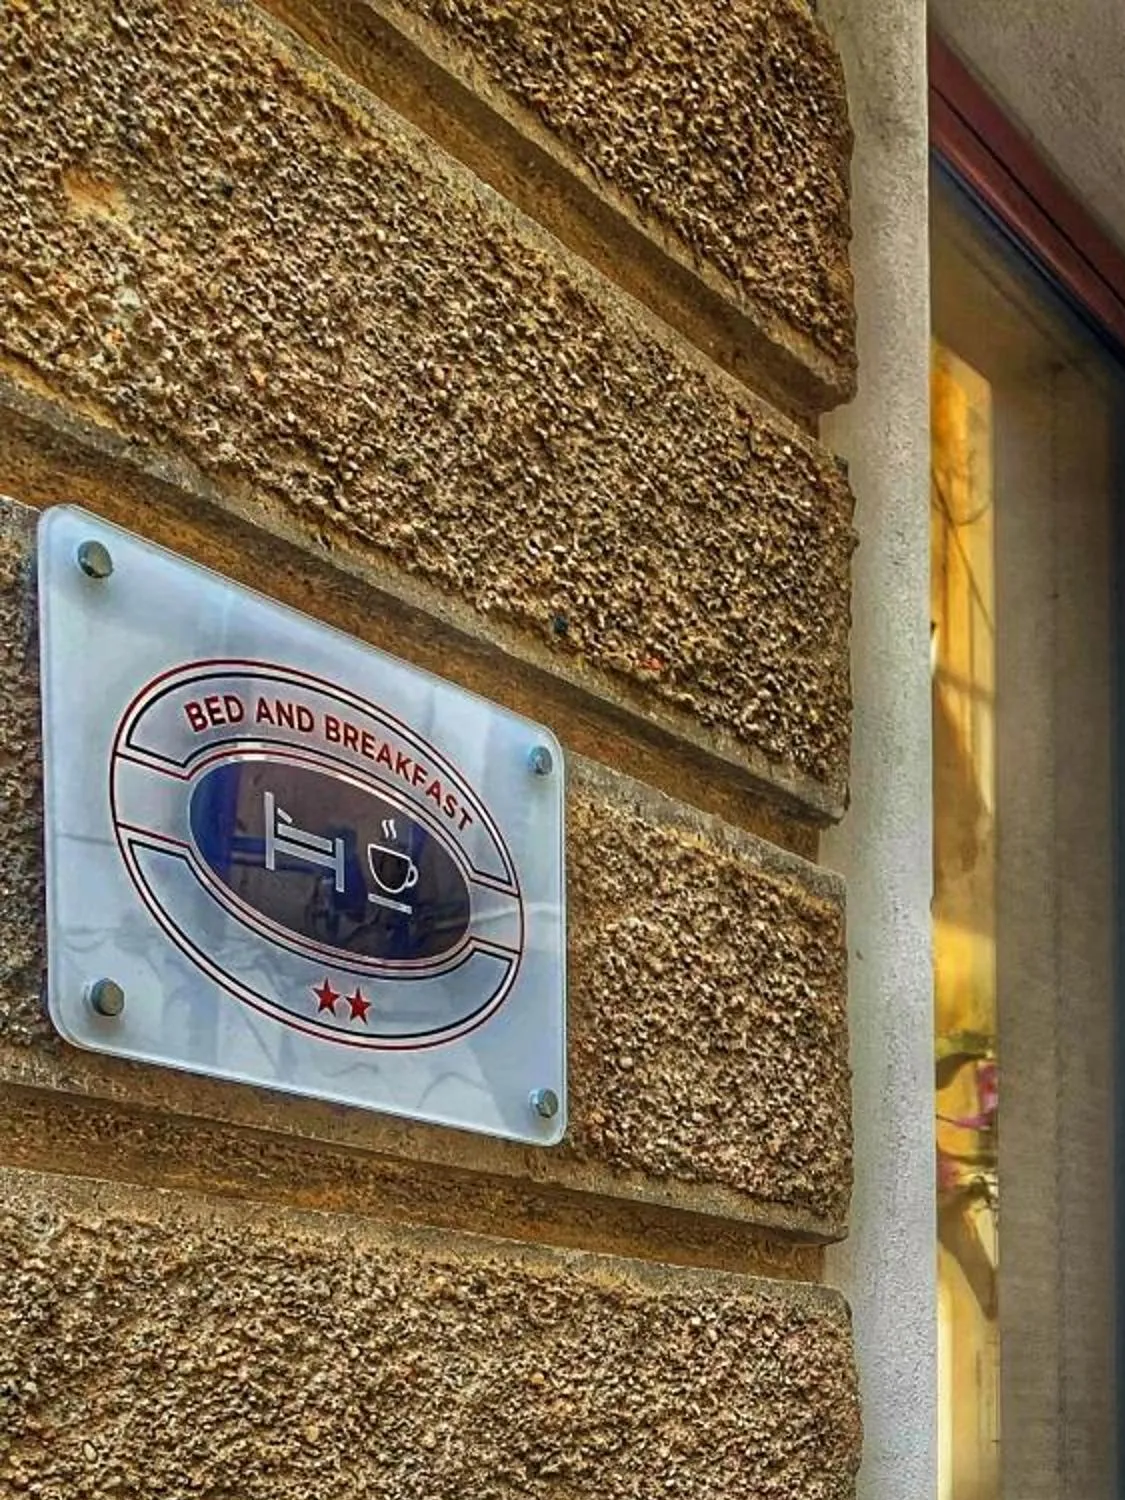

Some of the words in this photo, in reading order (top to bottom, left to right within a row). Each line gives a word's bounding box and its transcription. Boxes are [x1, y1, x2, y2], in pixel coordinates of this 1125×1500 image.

[184, 695, 244, 732] BED
[255, 697, 315, 733] AND
[325, 715, 473, 830] BREAKFAST
